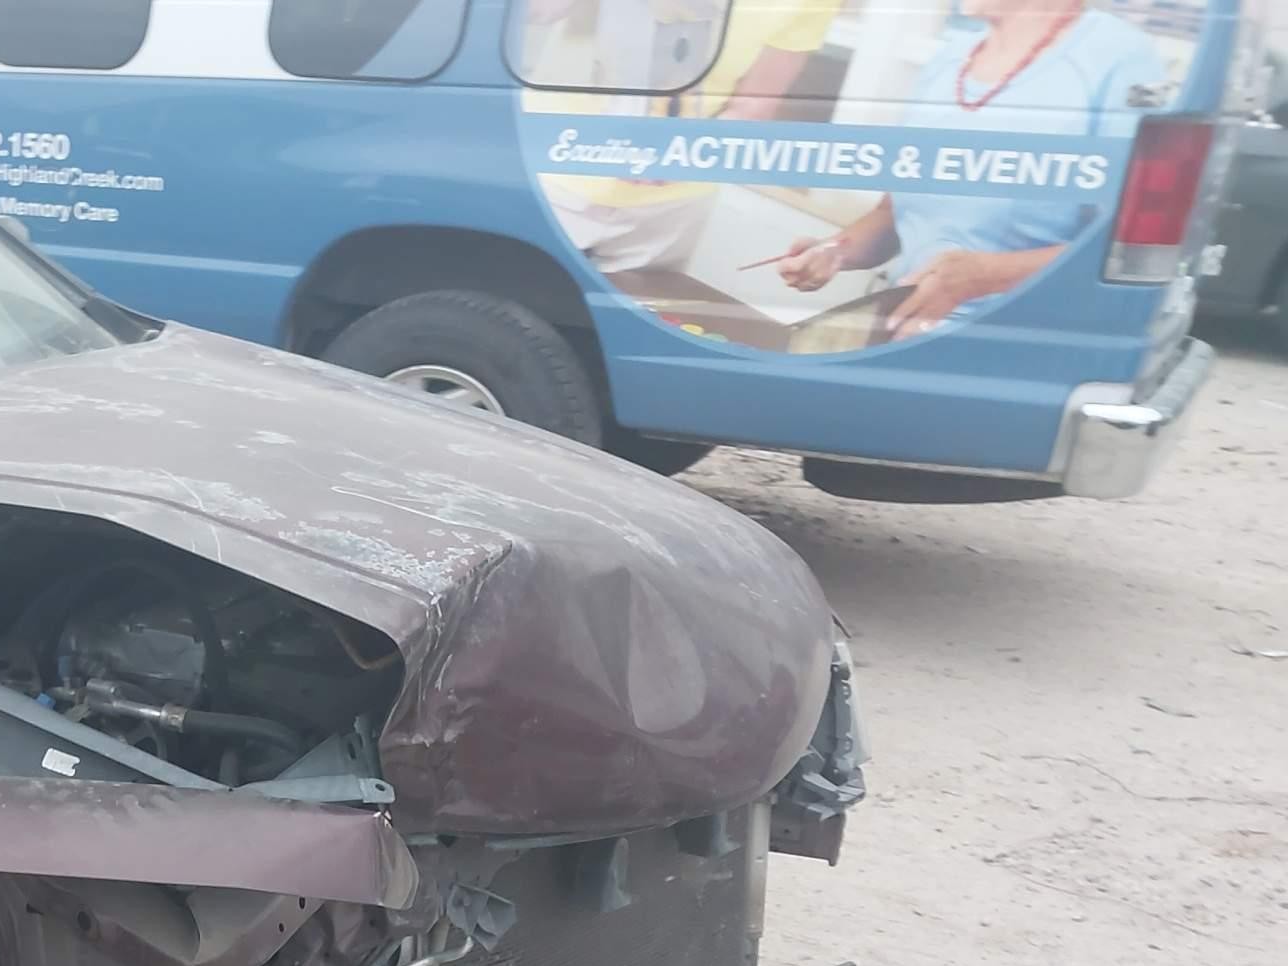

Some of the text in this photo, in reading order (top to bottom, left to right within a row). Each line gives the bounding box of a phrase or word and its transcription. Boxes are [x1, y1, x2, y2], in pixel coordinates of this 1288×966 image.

[548, 128, 1109, 189] Exciting ACTIVITIES & EVENTS
[73, 201, 120, 222] Care
